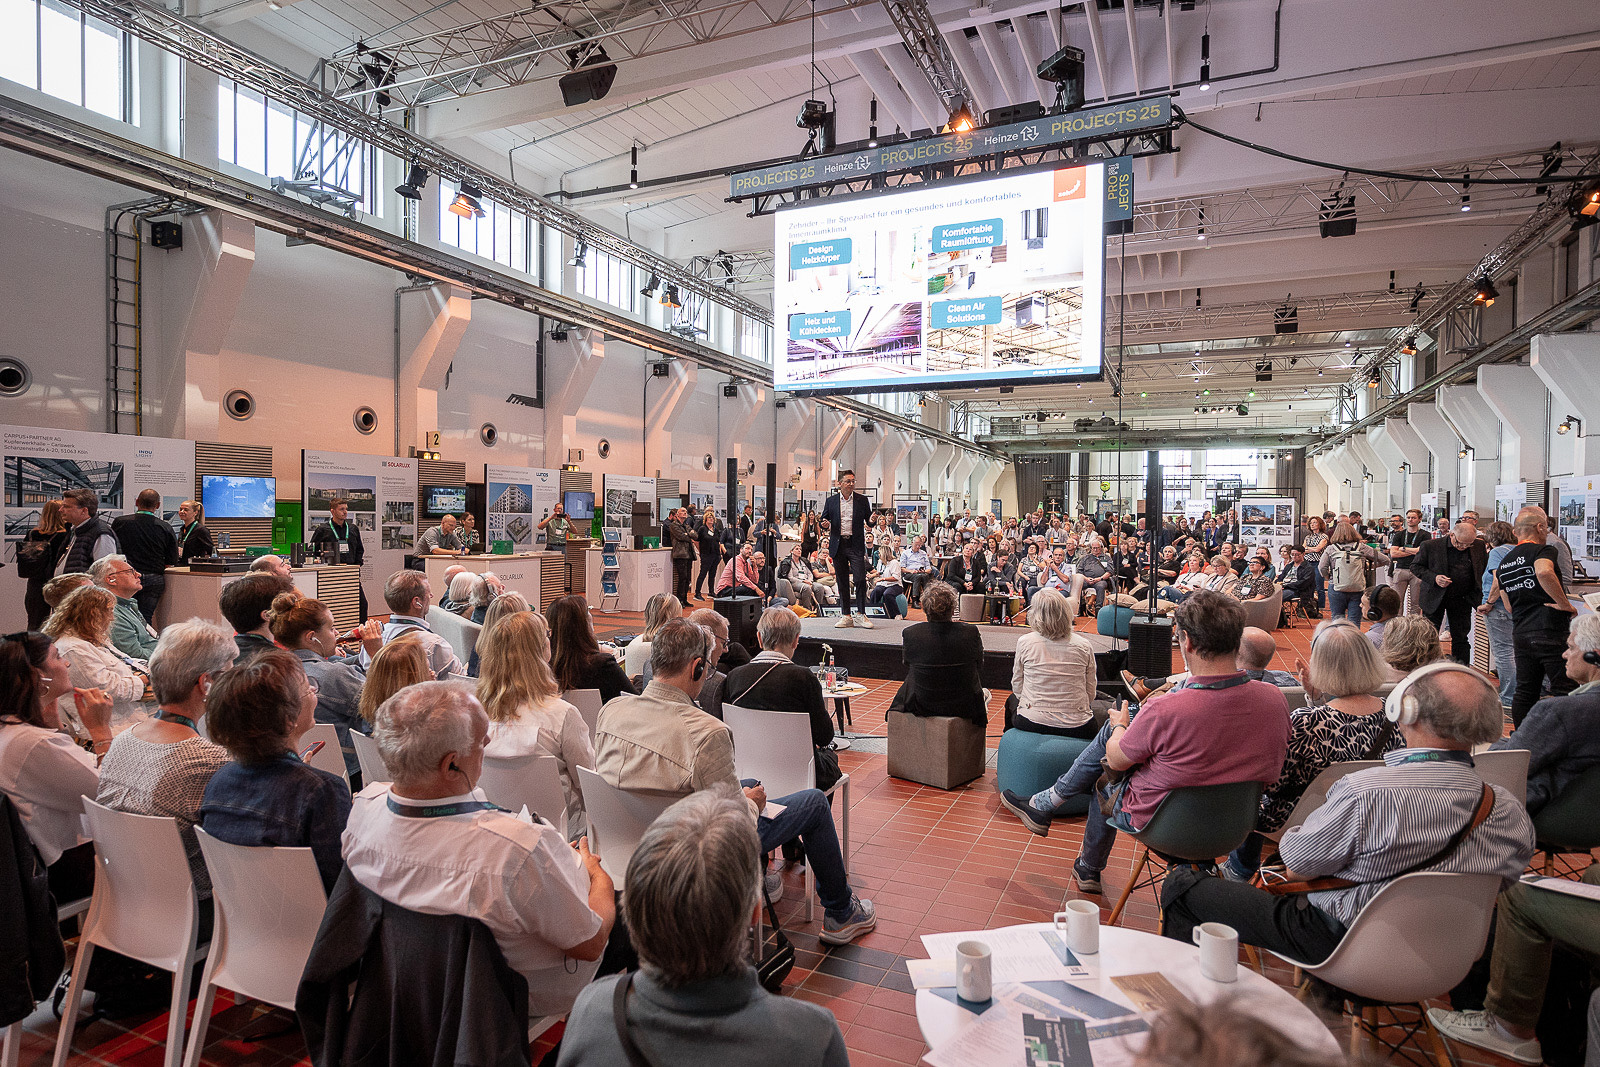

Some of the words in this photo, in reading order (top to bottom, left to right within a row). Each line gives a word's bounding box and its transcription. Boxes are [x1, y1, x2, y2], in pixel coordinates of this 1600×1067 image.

[736, 170, 798, 190] PROJECTS
[800, 166, 814, 180] 25
[824, 162, 853, 174] Heinze
[881, 142, 953, 165] PROJECTS
[955, 138, 973, 153] 25
[984, 131, 1018, 146] Heinze
[1051, 108, 1137, 135] PROJECTS
[1139, 104, 1161, 121] 25
[1108, 176, 1118, 200] PRO
[1119, 174, 1130, 211] JECTS
[789, 220, 818, 230] Zehnder
[839, 212, 875, 223] Spezialist
[905, 202, 944, 214] gesundes
[946, 199, 962, 208] und
[964, 191, 1022, 205] komfortables
[789, 226, 847, 238] Innenraumklima
[942, 224, 993, 238] Komfortable
[940, 234, 994, 248] Raumlüftung
[808, 245, 833, 254] Design
[802, 253, 840, 265] Heizkörper
[948, 304, 970, 313] Clean
[972, 302, 985, 311] Air
[805, 317, 821, 326] Heiz
[822, 316, 835, 324] und
[947, 313, 985, 323] Solutions
[800, 326, 841, 336] Kühldecken
[434, 434, 439, 445] 2
[578, 450, 582, 460] 1
[1500, 561, 1516, 570] Heinze
